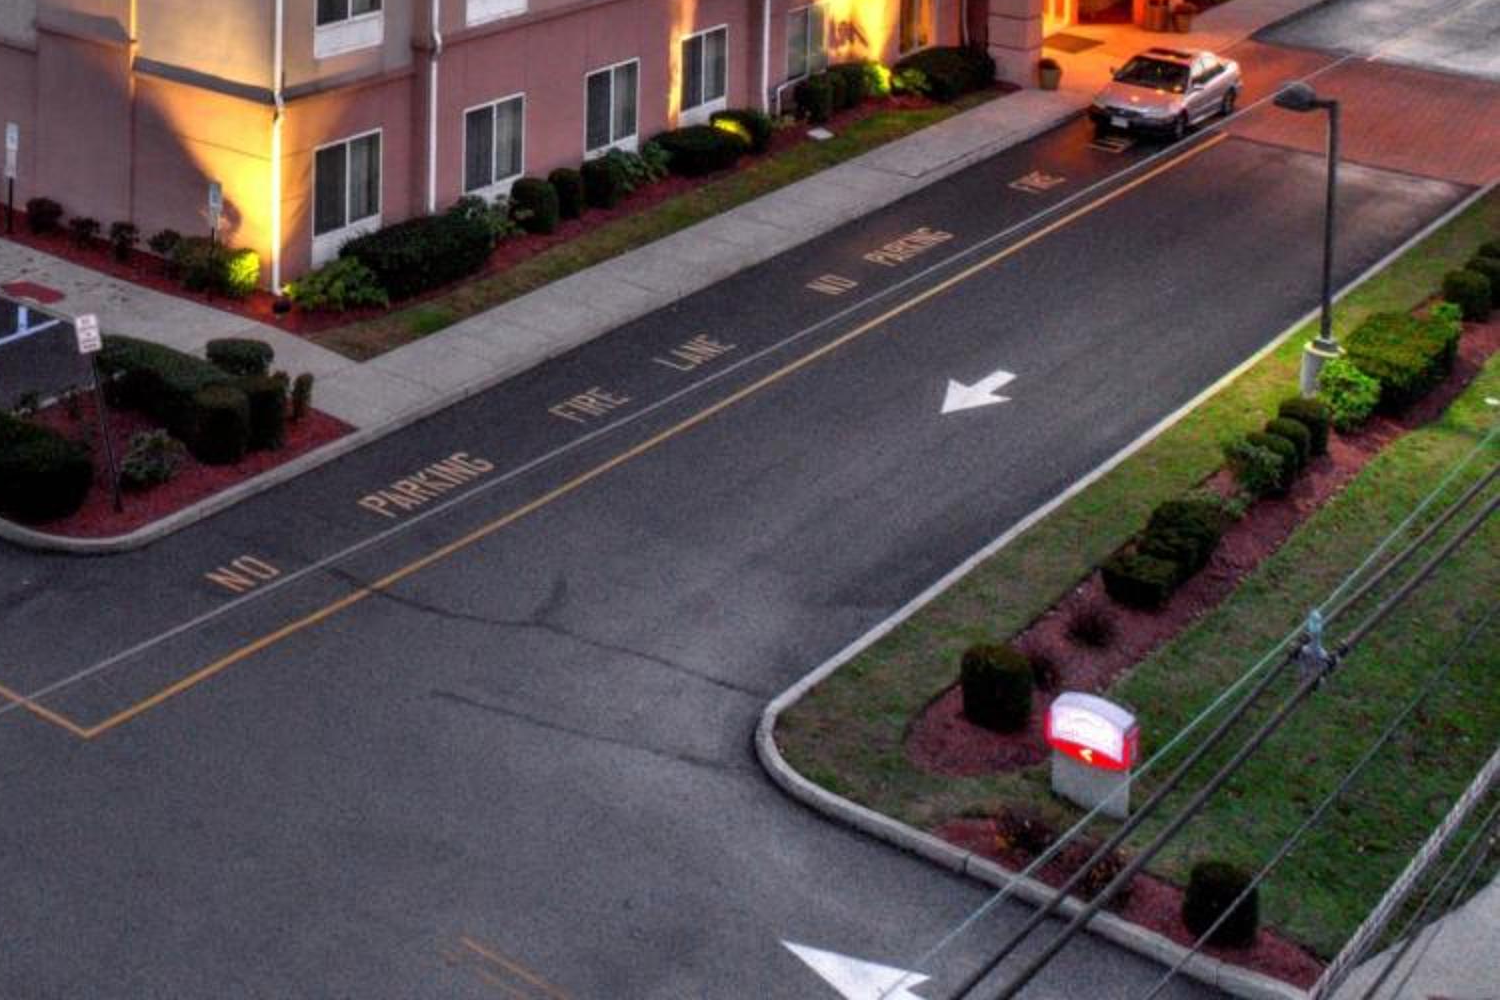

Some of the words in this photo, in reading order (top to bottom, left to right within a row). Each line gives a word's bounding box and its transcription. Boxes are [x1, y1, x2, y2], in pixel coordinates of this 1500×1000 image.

[806, 273, 858, 296] NO
[863, 227, 955, 267] PARKING
[203, 554, 281, 594] NO
[357, 451, 495, 518] PARKING
